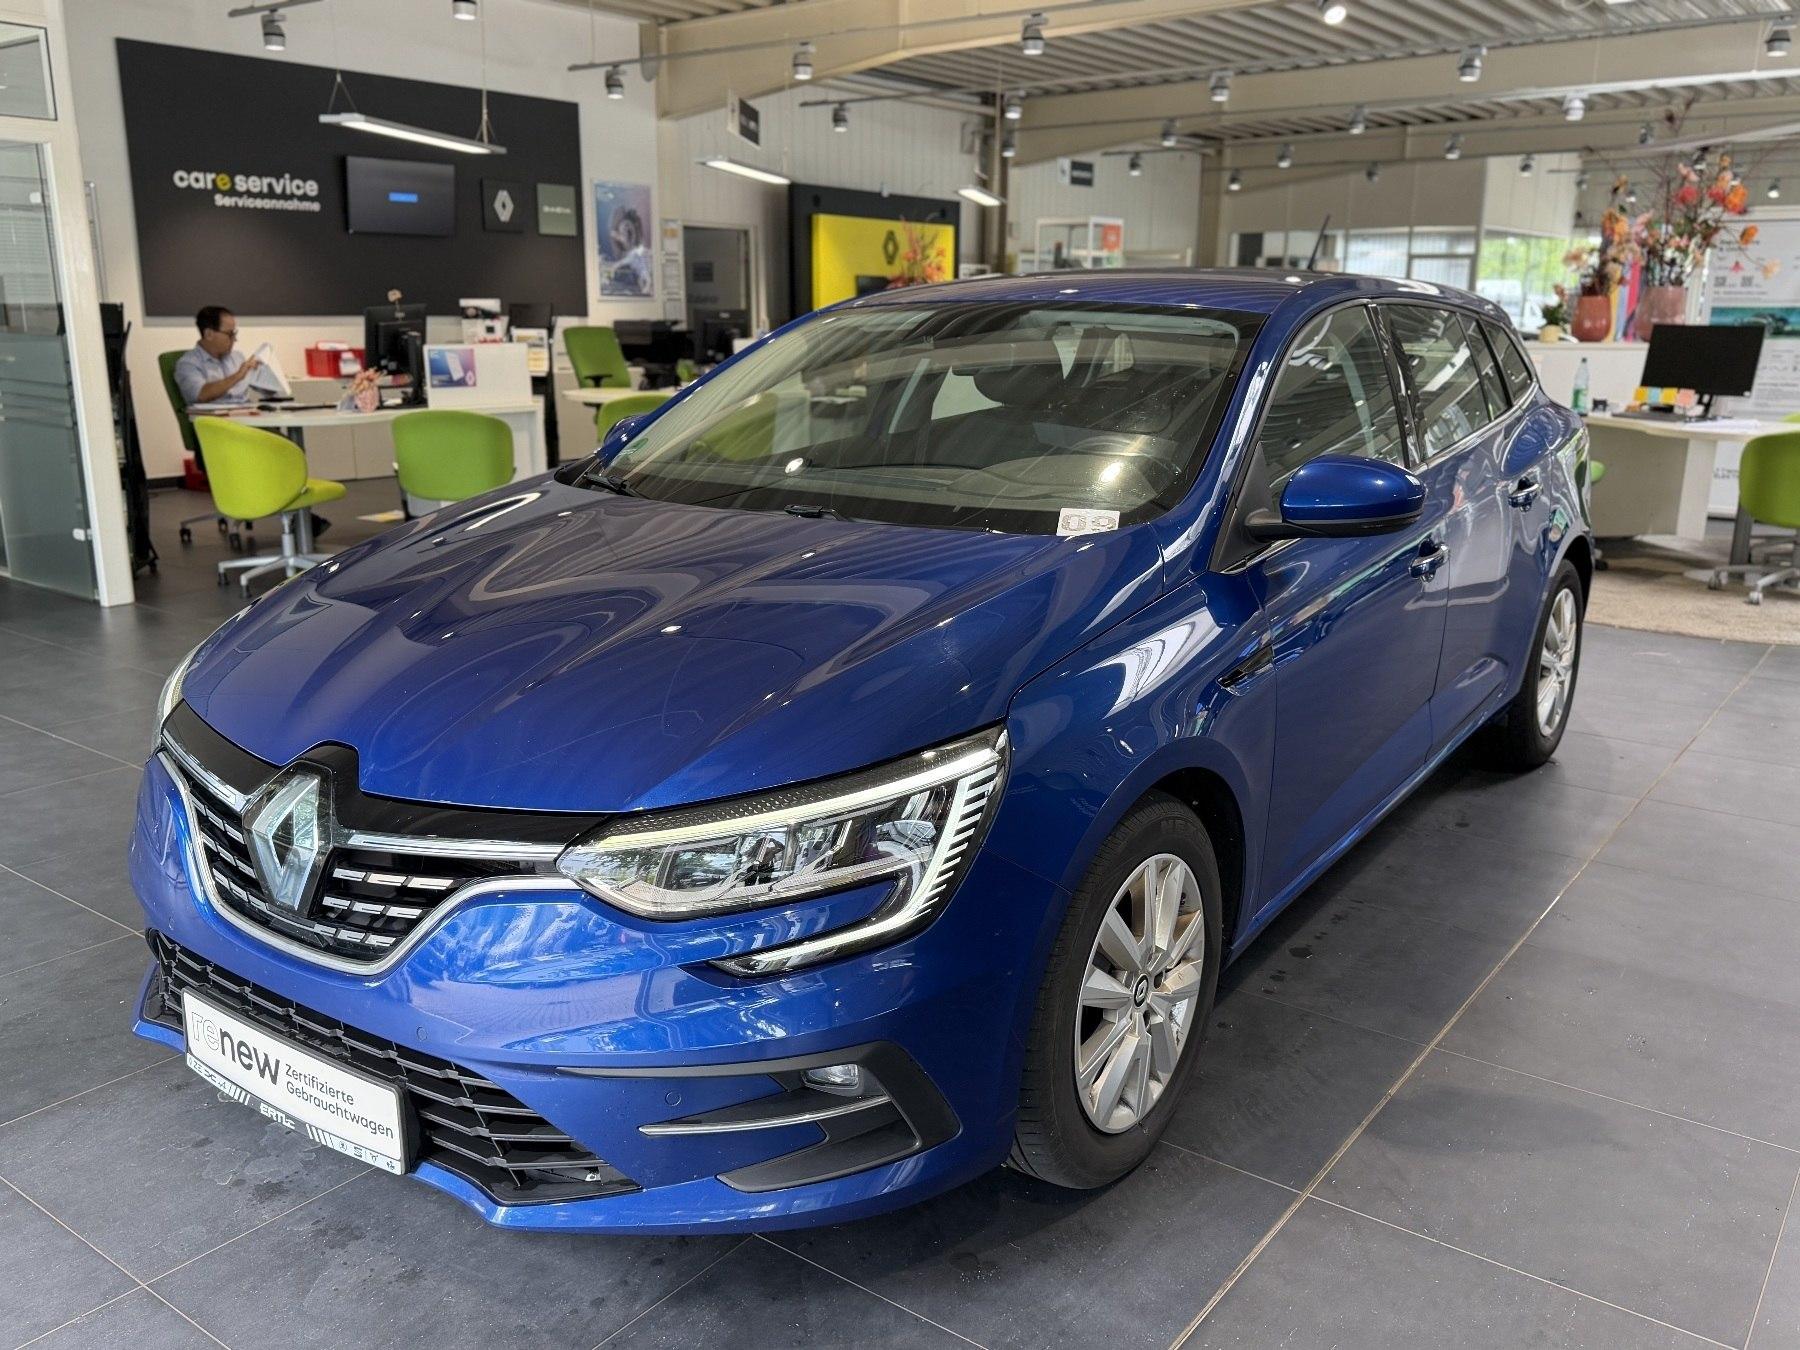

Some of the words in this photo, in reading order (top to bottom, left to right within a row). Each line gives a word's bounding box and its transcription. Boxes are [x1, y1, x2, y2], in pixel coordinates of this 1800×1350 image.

[173, 170, 232, 191] care
[234, 173, 319, 197] service
[214, 193, 321, 212] Serviceannahme
[191, 1011, 281, 1086] renew
[285, 1063, 354, 1106] Zertifizierte
[286, 1081, 394, 1139] Gebrauchtwagen
